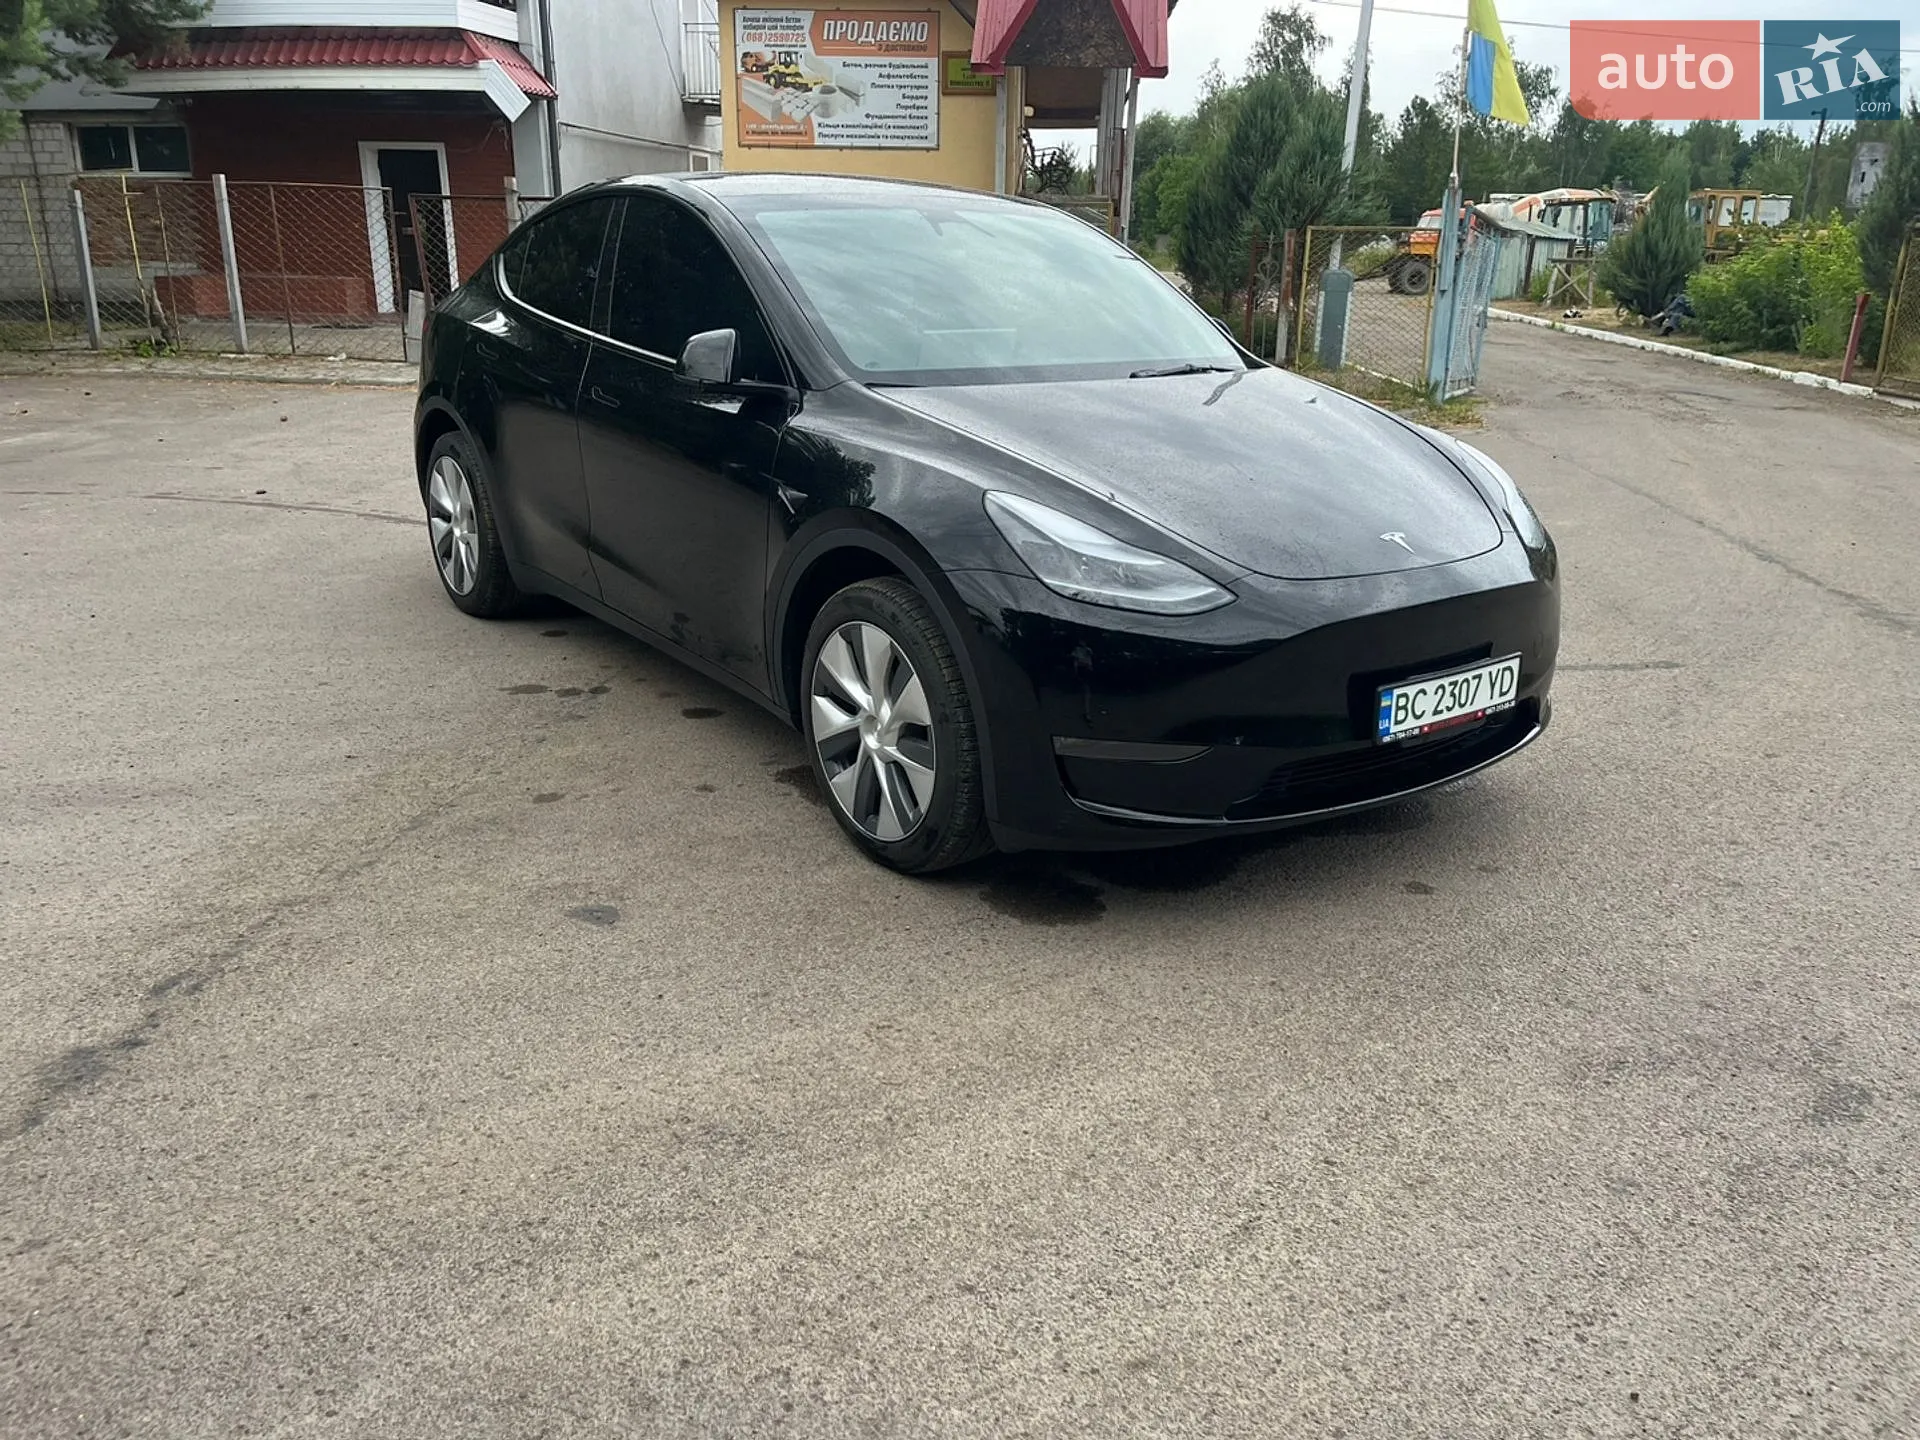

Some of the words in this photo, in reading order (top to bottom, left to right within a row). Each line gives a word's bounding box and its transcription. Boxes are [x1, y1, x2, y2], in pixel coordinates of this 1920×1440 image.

[822, 20, 929, 45] ПРОДАЄМО
[878, 72, 929, 80] Асфальтобетон
[1394, 688, 1427, 726] BC
[1432, 673, 1483, 716] 2307
[1488, 665, 1514, 700] YD
[1378, 719, 1389, 729] UA
